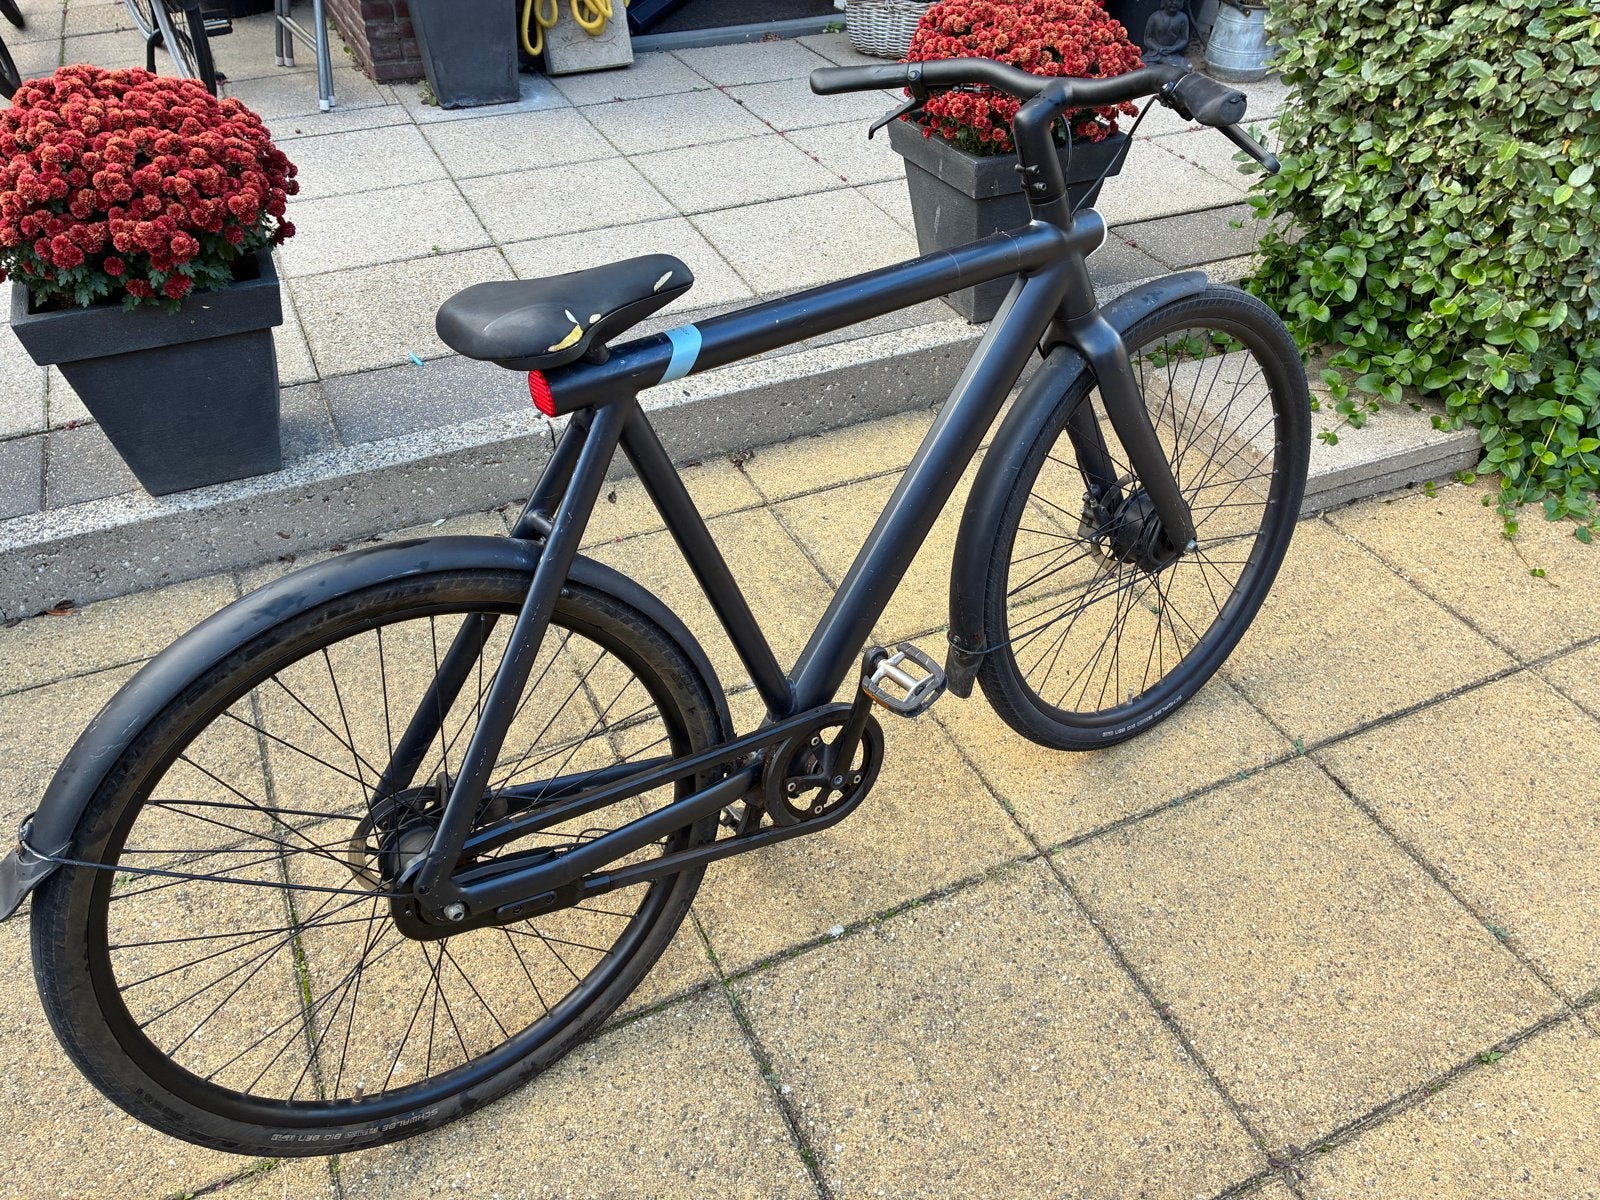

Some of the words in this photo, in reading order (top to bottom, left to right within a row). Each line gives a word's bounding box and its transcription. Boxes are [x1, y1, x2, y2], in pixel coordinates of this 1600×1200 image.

[381, 1107, 439, 1132] SCHWALBE
[298, 1133, 319, 1142] BEN
[322, 1133, 342, 1141] BIG
